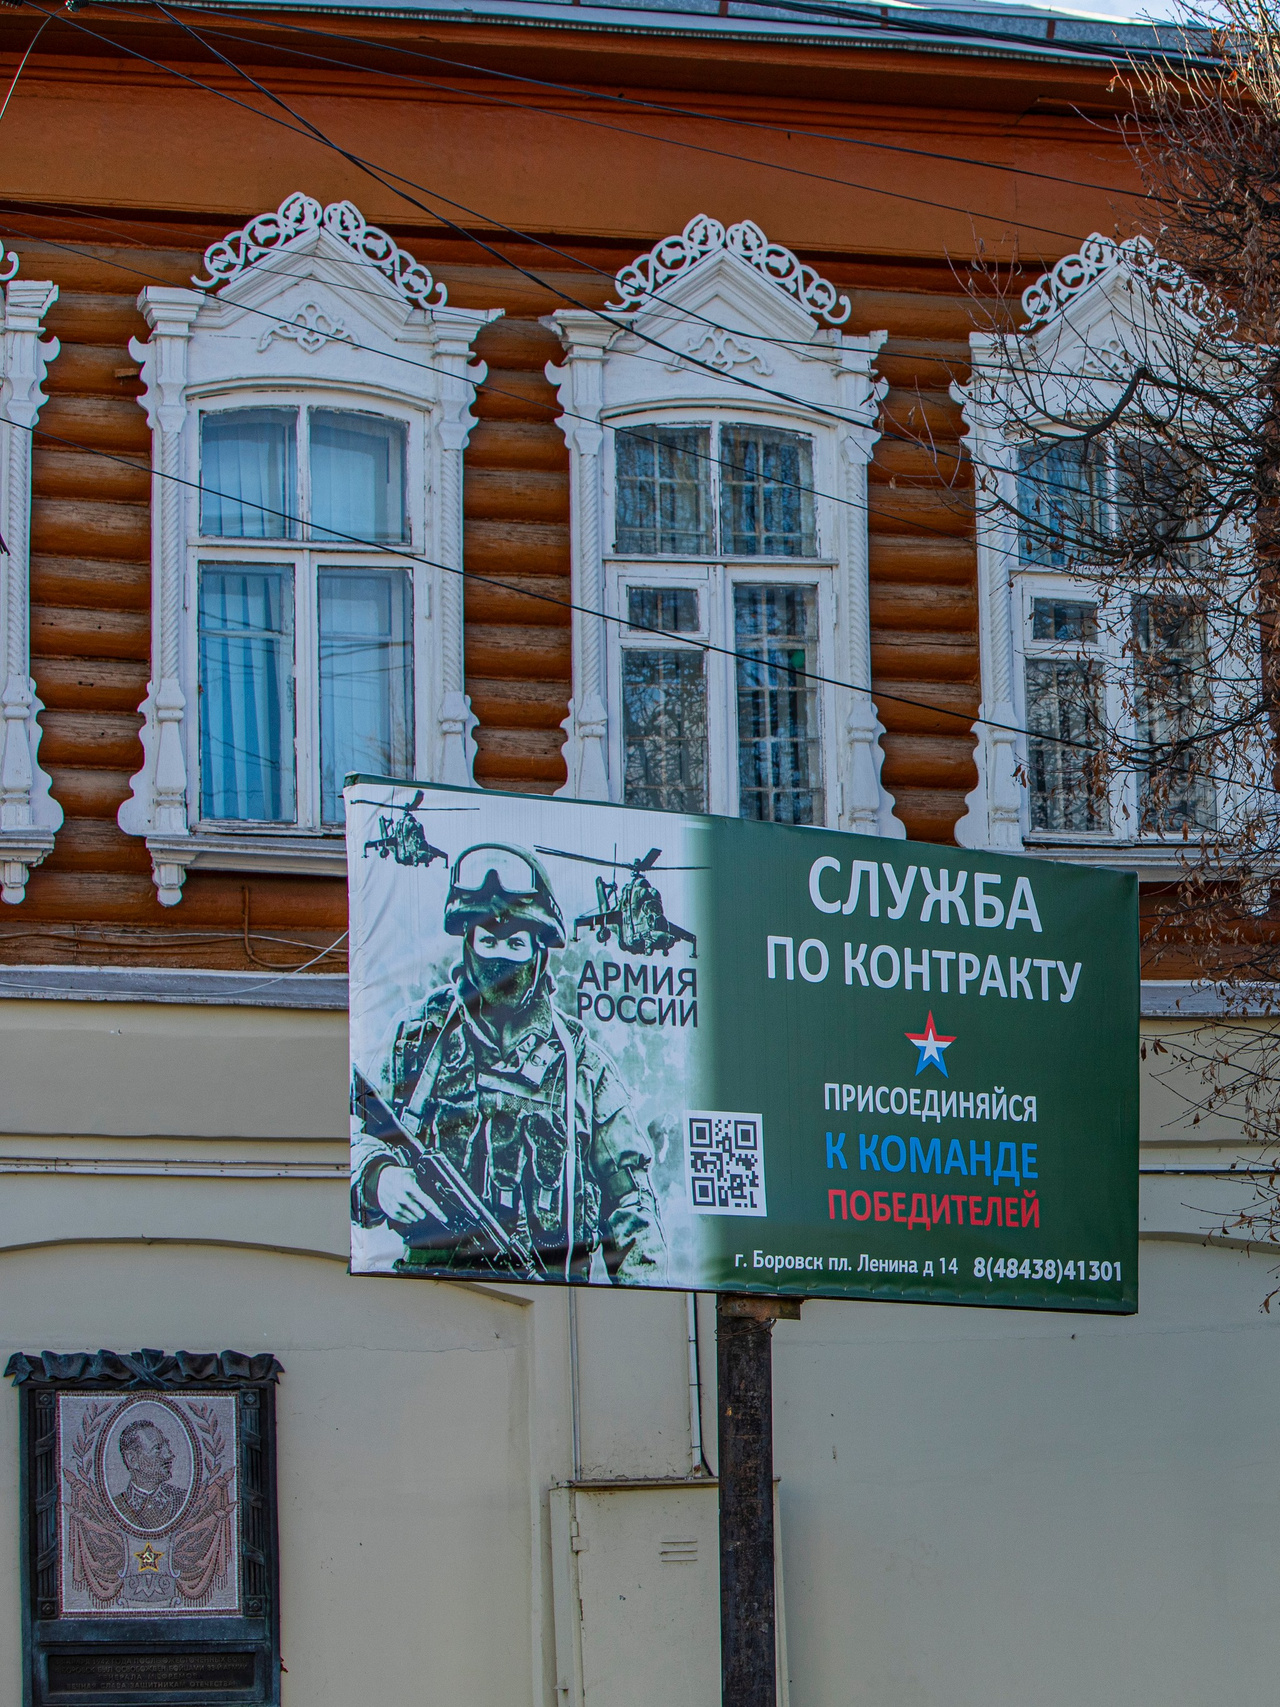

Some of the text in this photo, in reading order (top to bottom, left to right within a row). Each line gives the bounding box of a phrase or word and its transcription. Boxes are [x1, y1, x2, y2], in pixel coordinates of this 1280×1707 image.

[808, 855, 1043, 933] СЛУЖБА
[577, 959, 699, 998] АРМИЯ
[766, 935, 1083, 1004] ПО КОНТРАКТУ
[577, 992, 699, 1028] РОССИИ
[823, 1082, 1038, 1124] ПРИСОЕДИНЯЙСЯ
[825, 1131, 1039, 1187] К КОМАНДЕ
[827, 1188, 1042, 1232] ПОБЕДИТЕЛЕЙ
[734, 1250, 1123, 1286] г. Боровск пл. Ленина д 14 8(48438)41301
